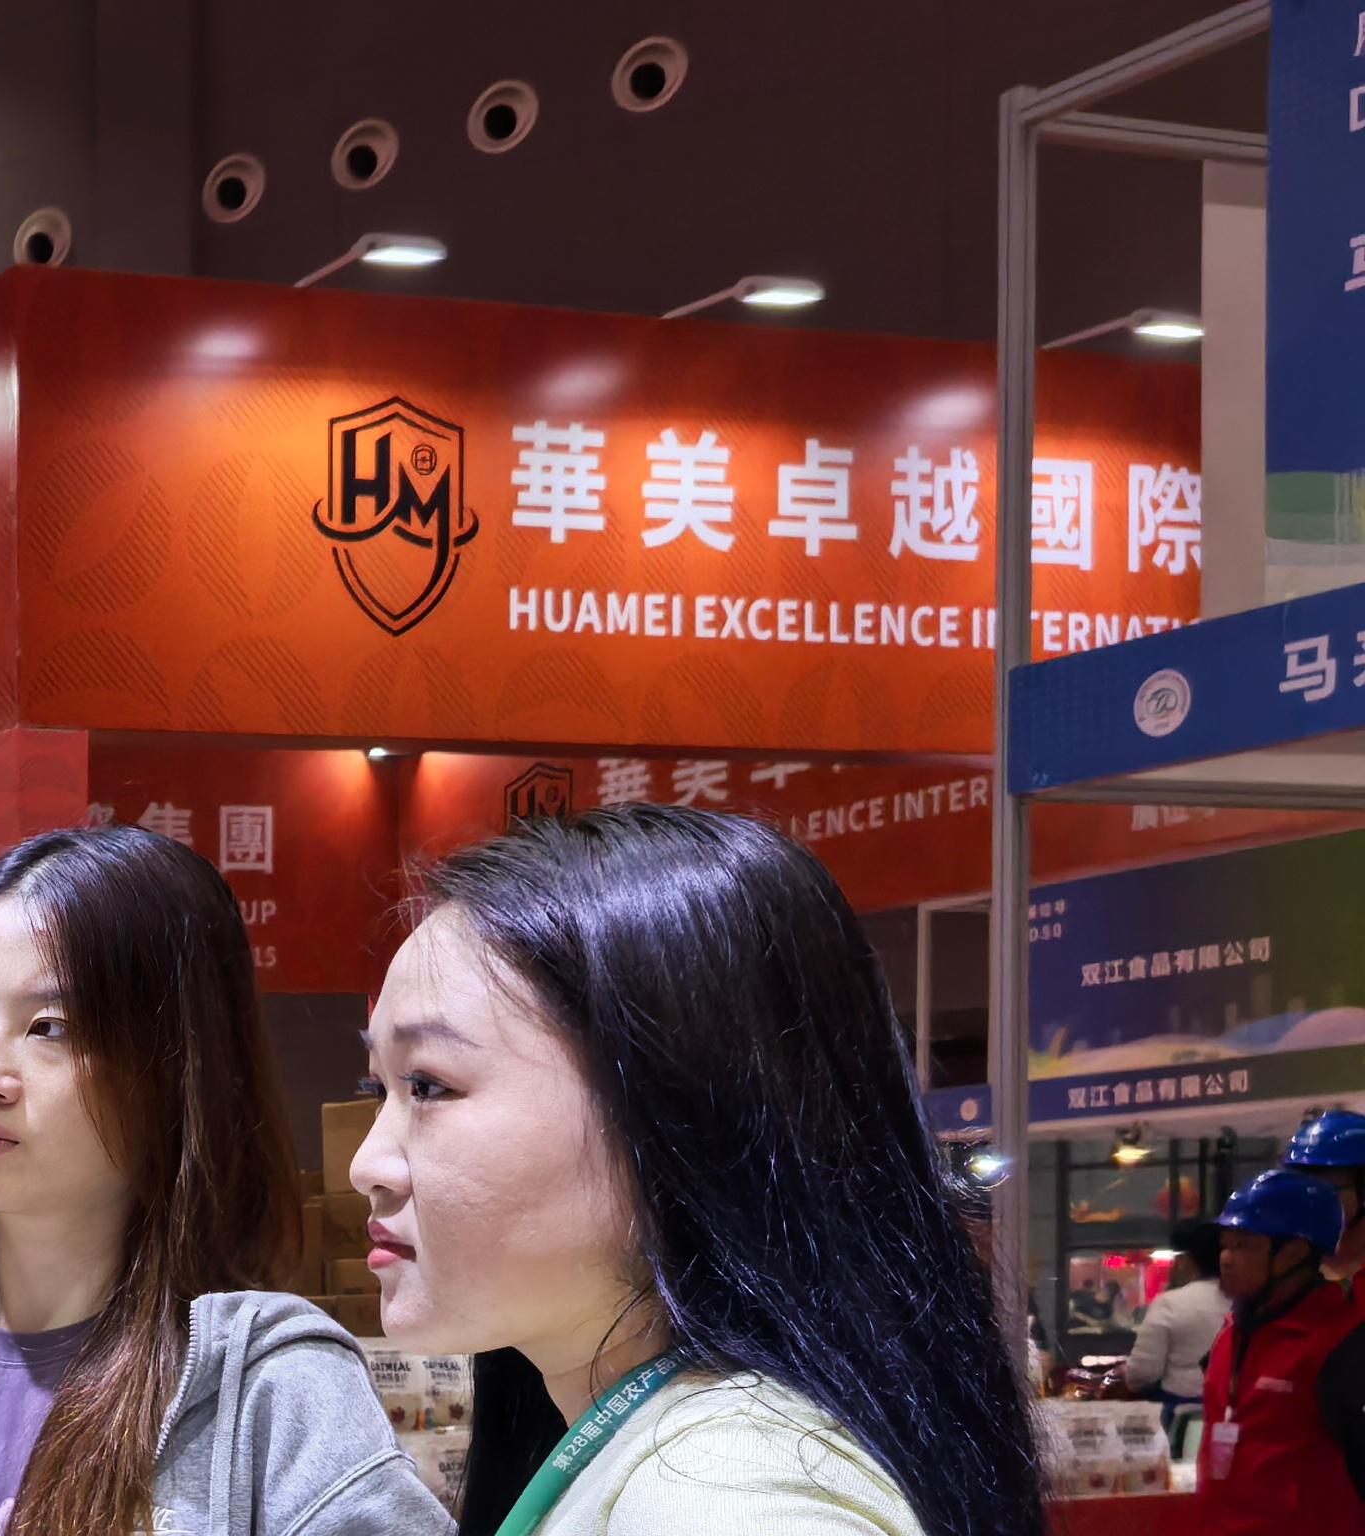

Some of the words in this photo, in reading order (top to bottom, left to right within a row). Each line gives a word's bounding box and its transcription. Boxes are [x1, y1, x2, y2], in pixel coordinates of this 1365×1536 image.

[508, 587, 683, 638] HUAMEI
[694, 594, 961, 649] EXCELLENCE
[1279, 628, 1365, 703] 马
[893, 776, 989, 822] INTER
[239, 900, 277, 925] UP
[1080, 936, 1271, 987] 双江食品有限公司
[1068, 1069, 1249, 1110] 双江食品有限公司
[552, 1356, 678, 1472] 第28届中国农产品
